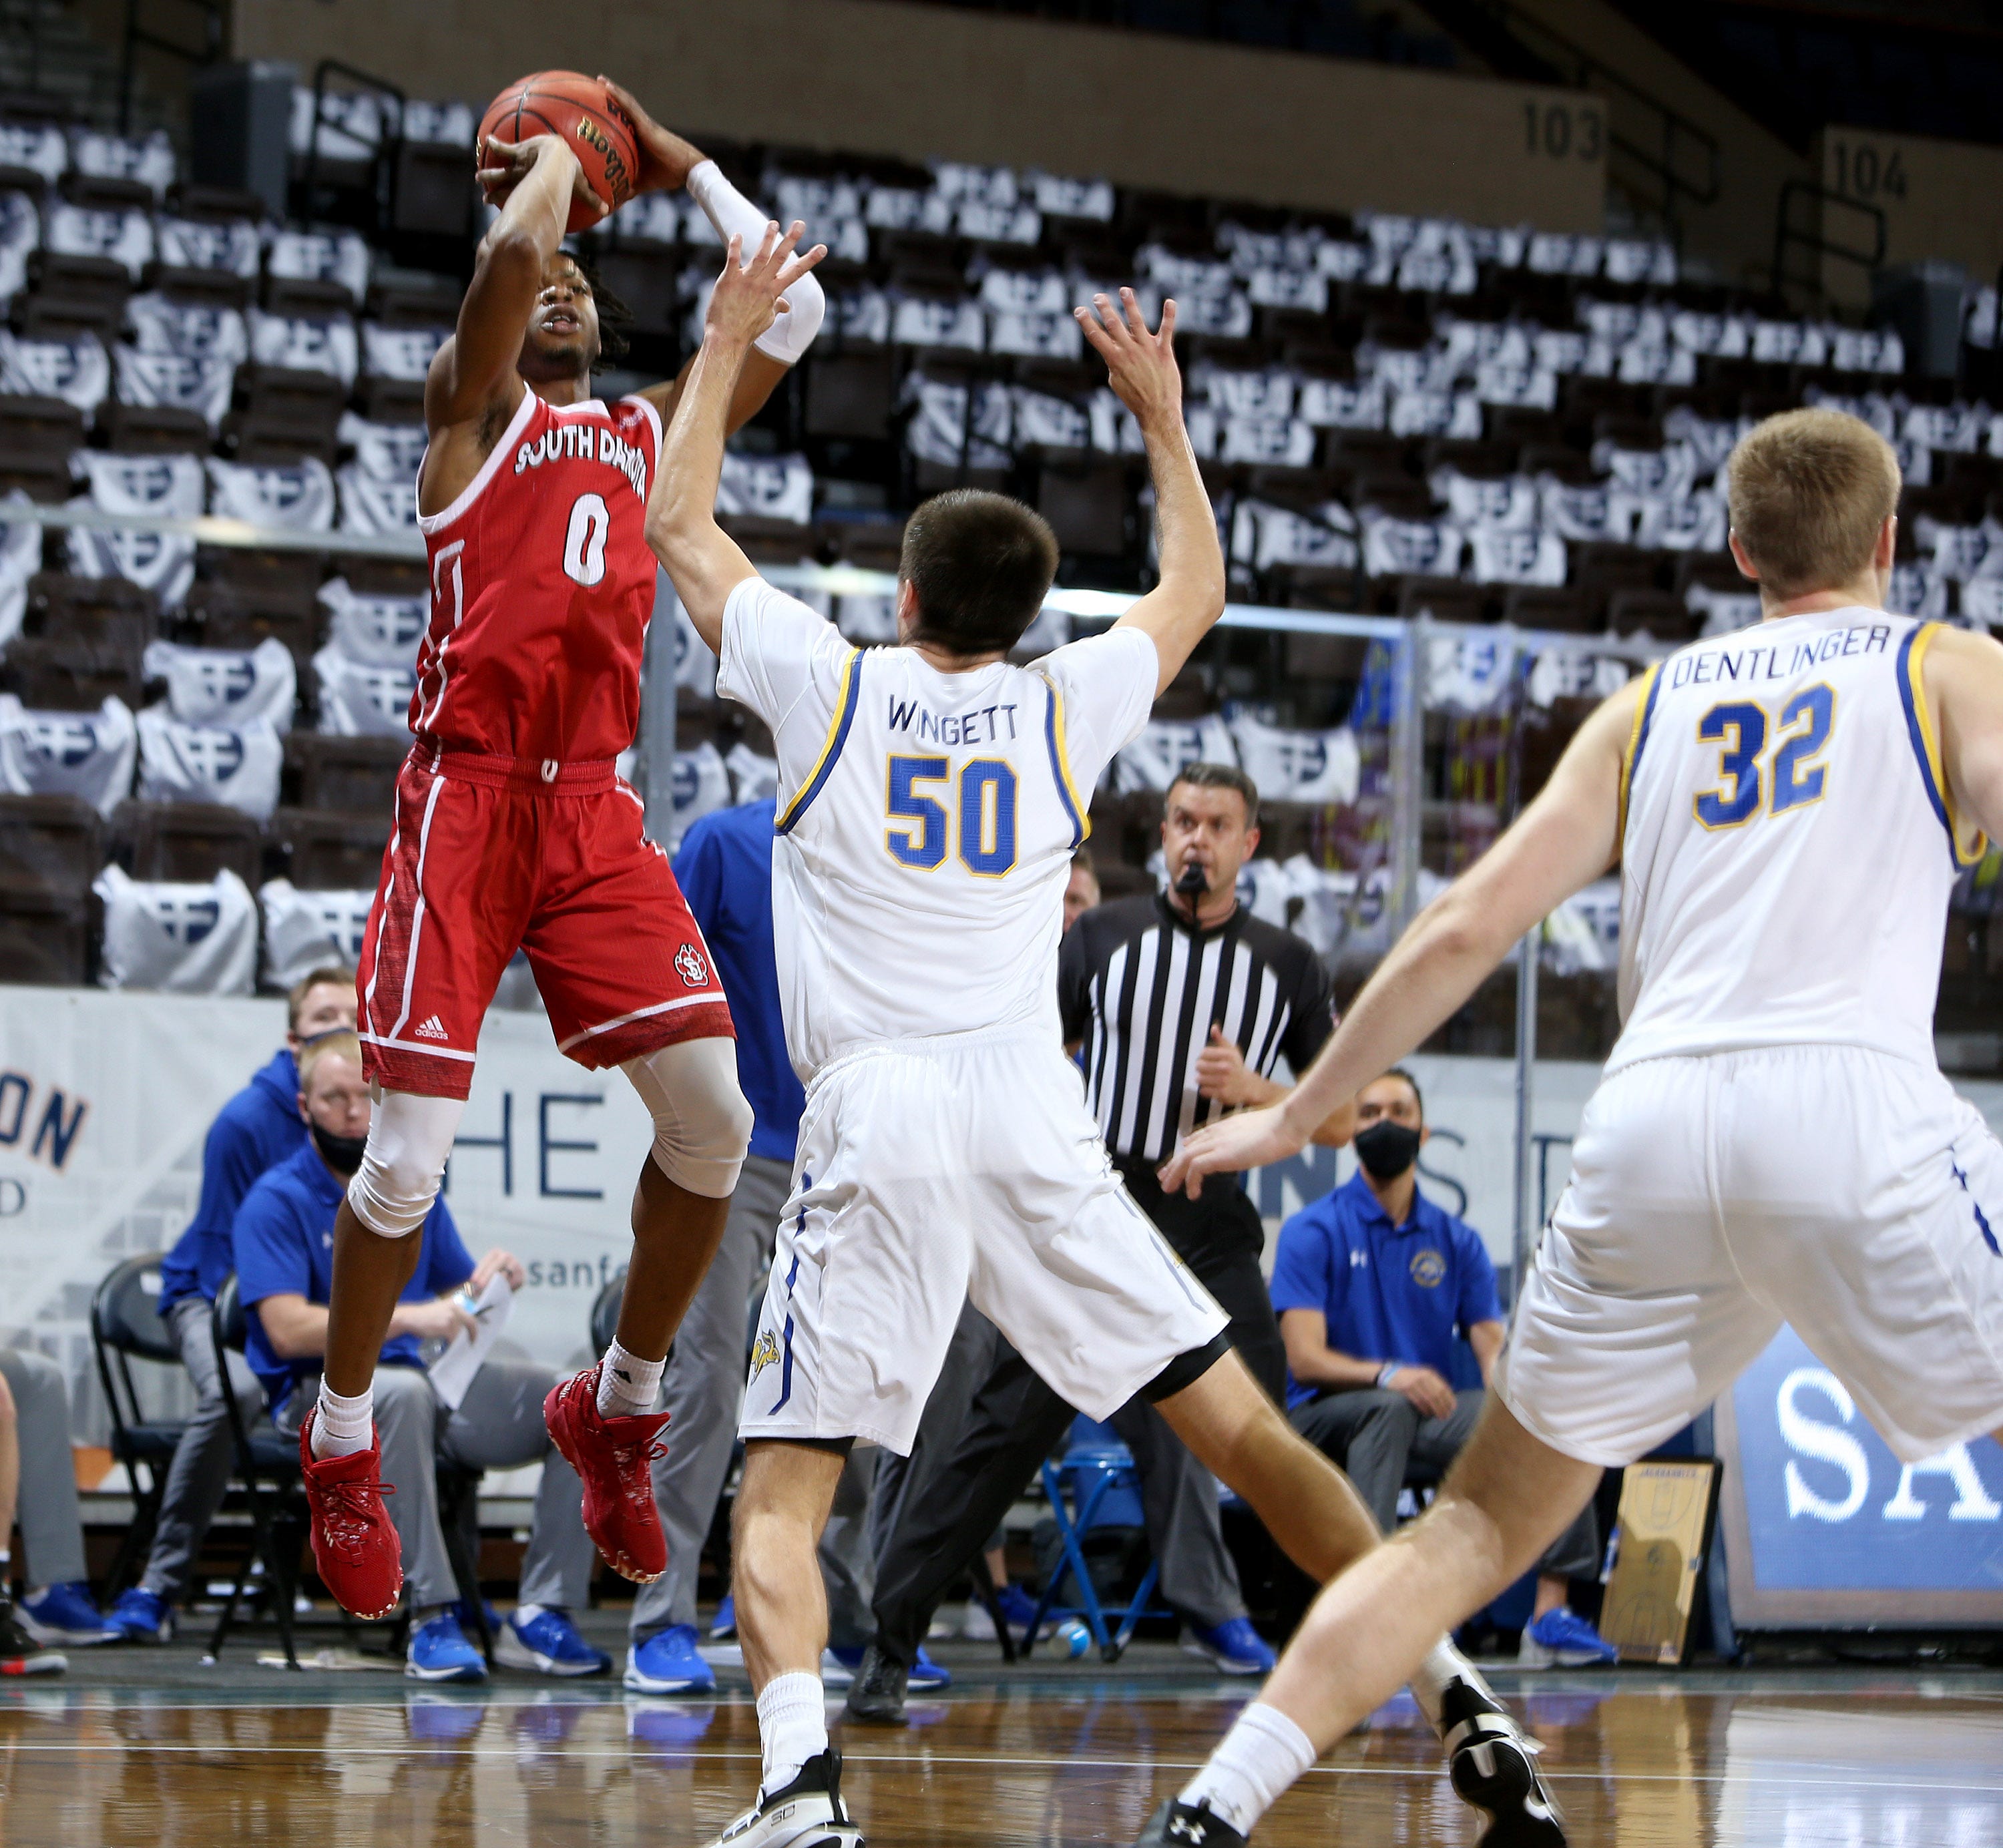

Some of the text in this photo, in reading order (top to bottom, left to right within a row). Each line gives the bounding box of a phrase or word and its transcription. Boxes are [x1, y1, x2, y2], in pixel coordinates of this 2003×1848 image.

[1523, 101, 1602, 160] 103
[1833, 138, 1908, 200] 104
[514, 425, 594, 475] SOUTH
[563, 492, 610, 586] 0
[1673, 626, 1891, 690] DENTLINGER
[889, 694, 1018, 745] WINGETT
[1693, 680, 1837, 832] 32
[884, 752, 1020, 879] 50
[415, 1029, 449, 1040] adidas
[1776, 1366, 2002, 1523] SA
